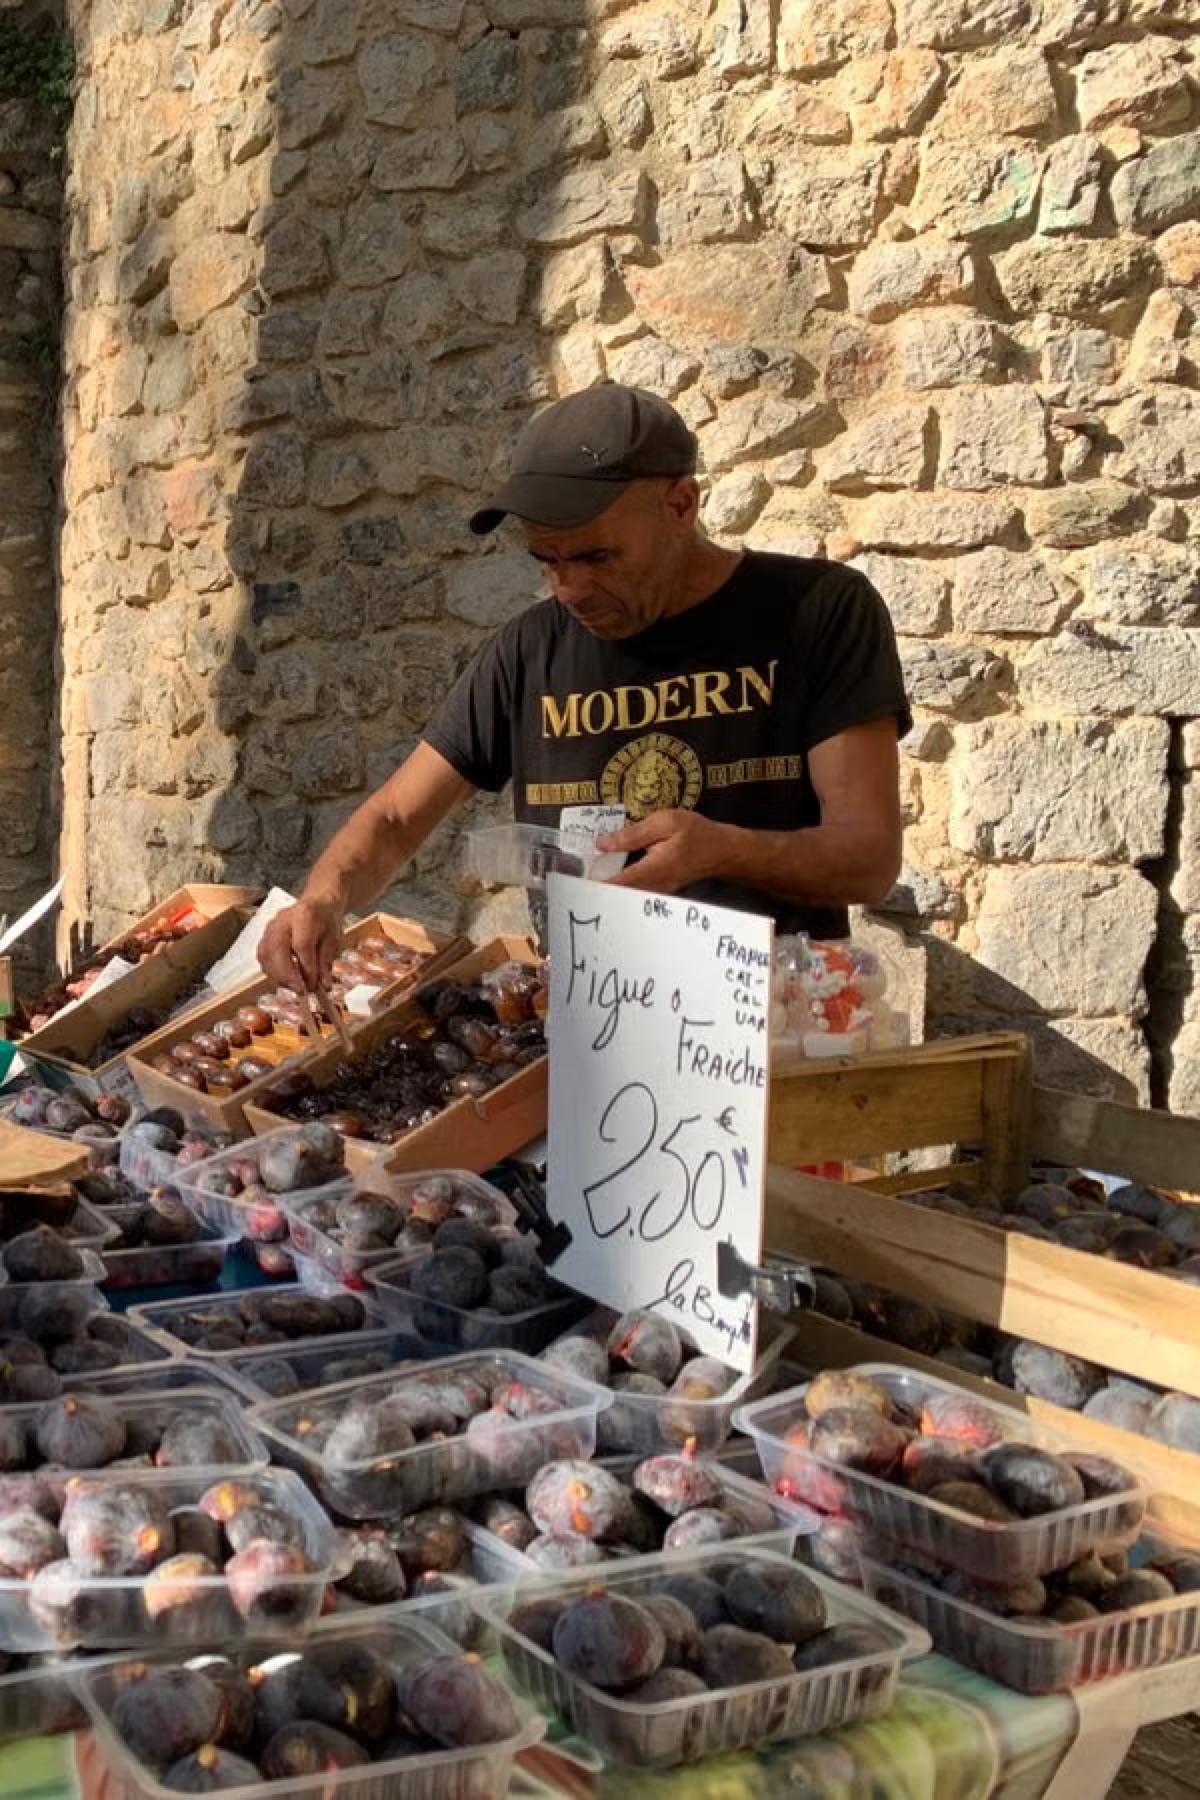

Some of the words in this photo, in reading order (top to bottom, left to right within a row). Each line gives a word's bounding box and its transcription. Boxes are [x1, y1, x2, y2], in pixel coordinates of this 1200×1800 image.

[541, 660, 779, 739] MODERN
[566, 911, 655, 1051] Figue
[583, 1081, 726, 1242] 2.50
